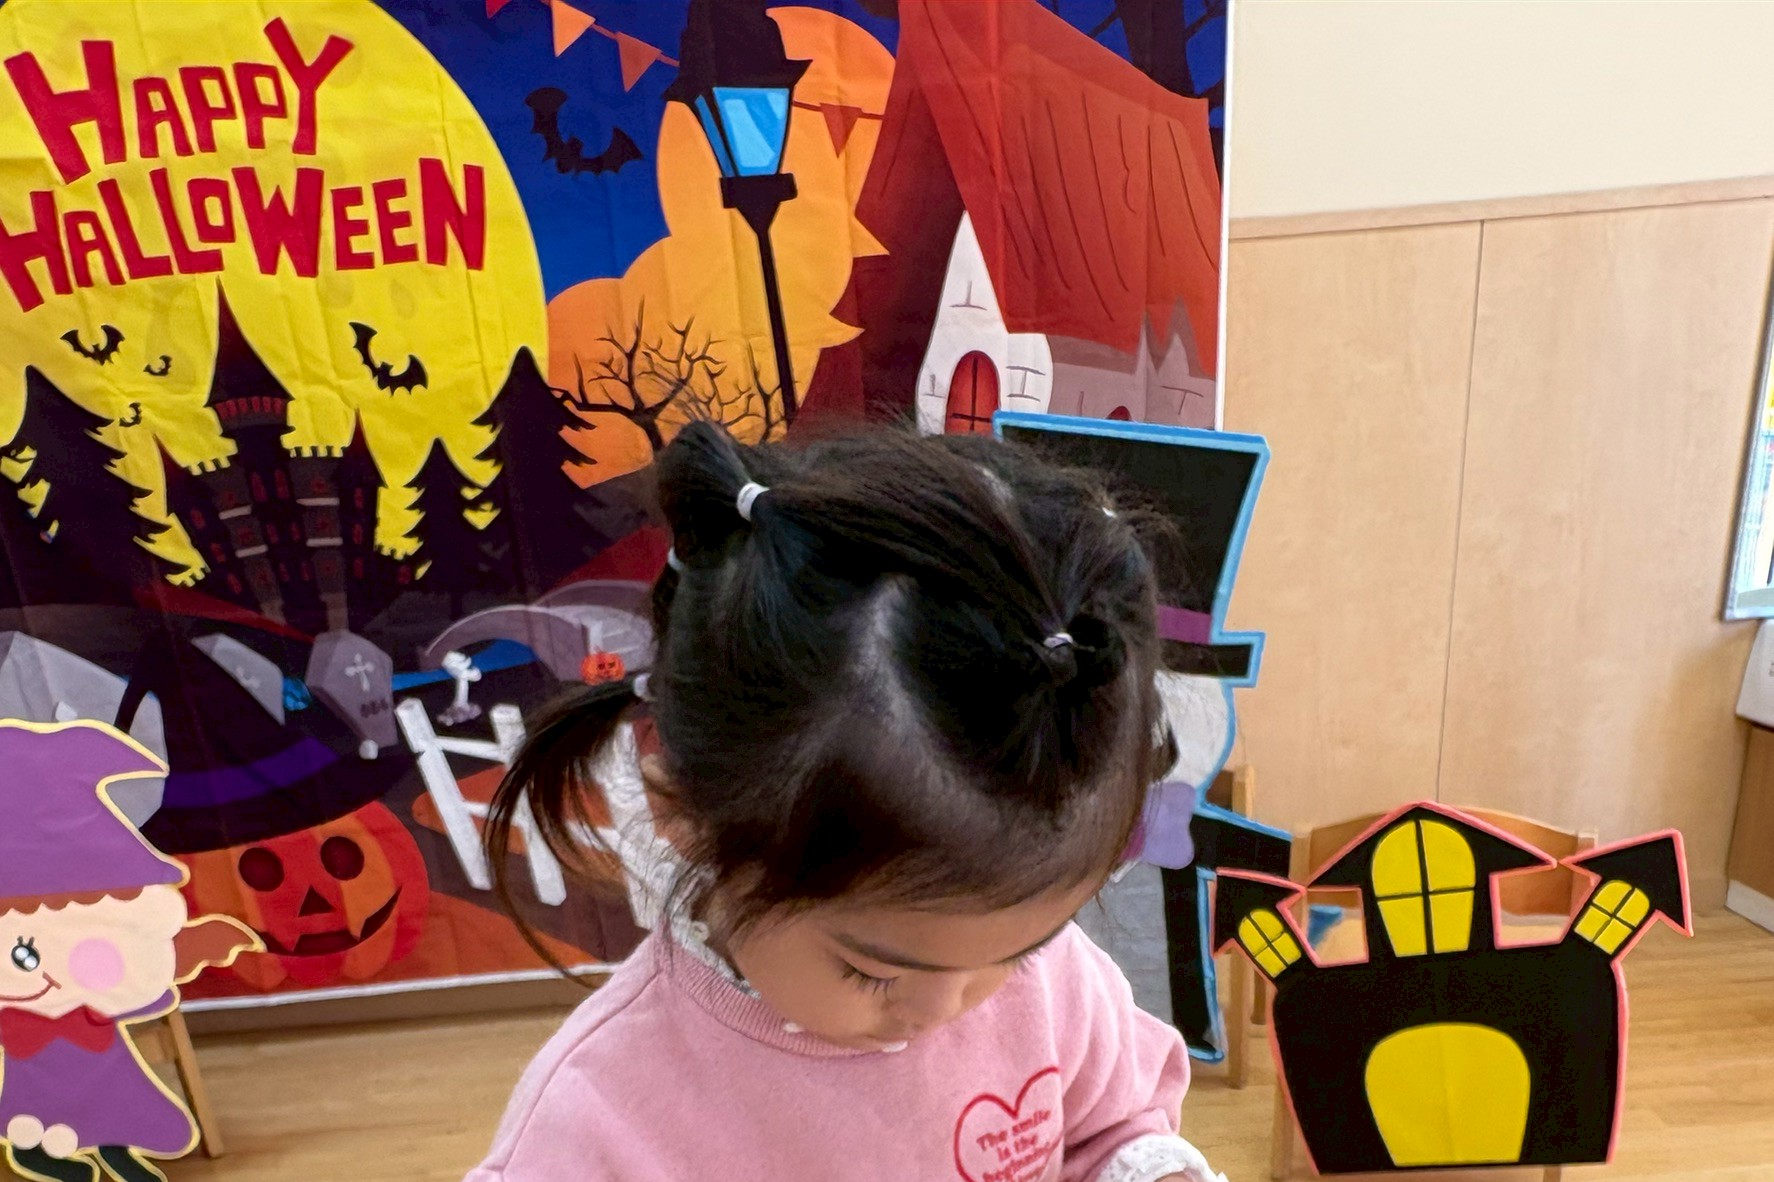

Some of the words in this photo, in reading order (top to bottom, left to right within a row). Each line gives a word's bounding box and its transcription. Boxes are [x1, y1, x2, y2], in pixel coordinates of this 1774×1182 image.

[4, 17, 354, 184] HAPPY
[0, 157, 485, 312] HALLOWEEN
[976, 1130, 1008, 1151] The
